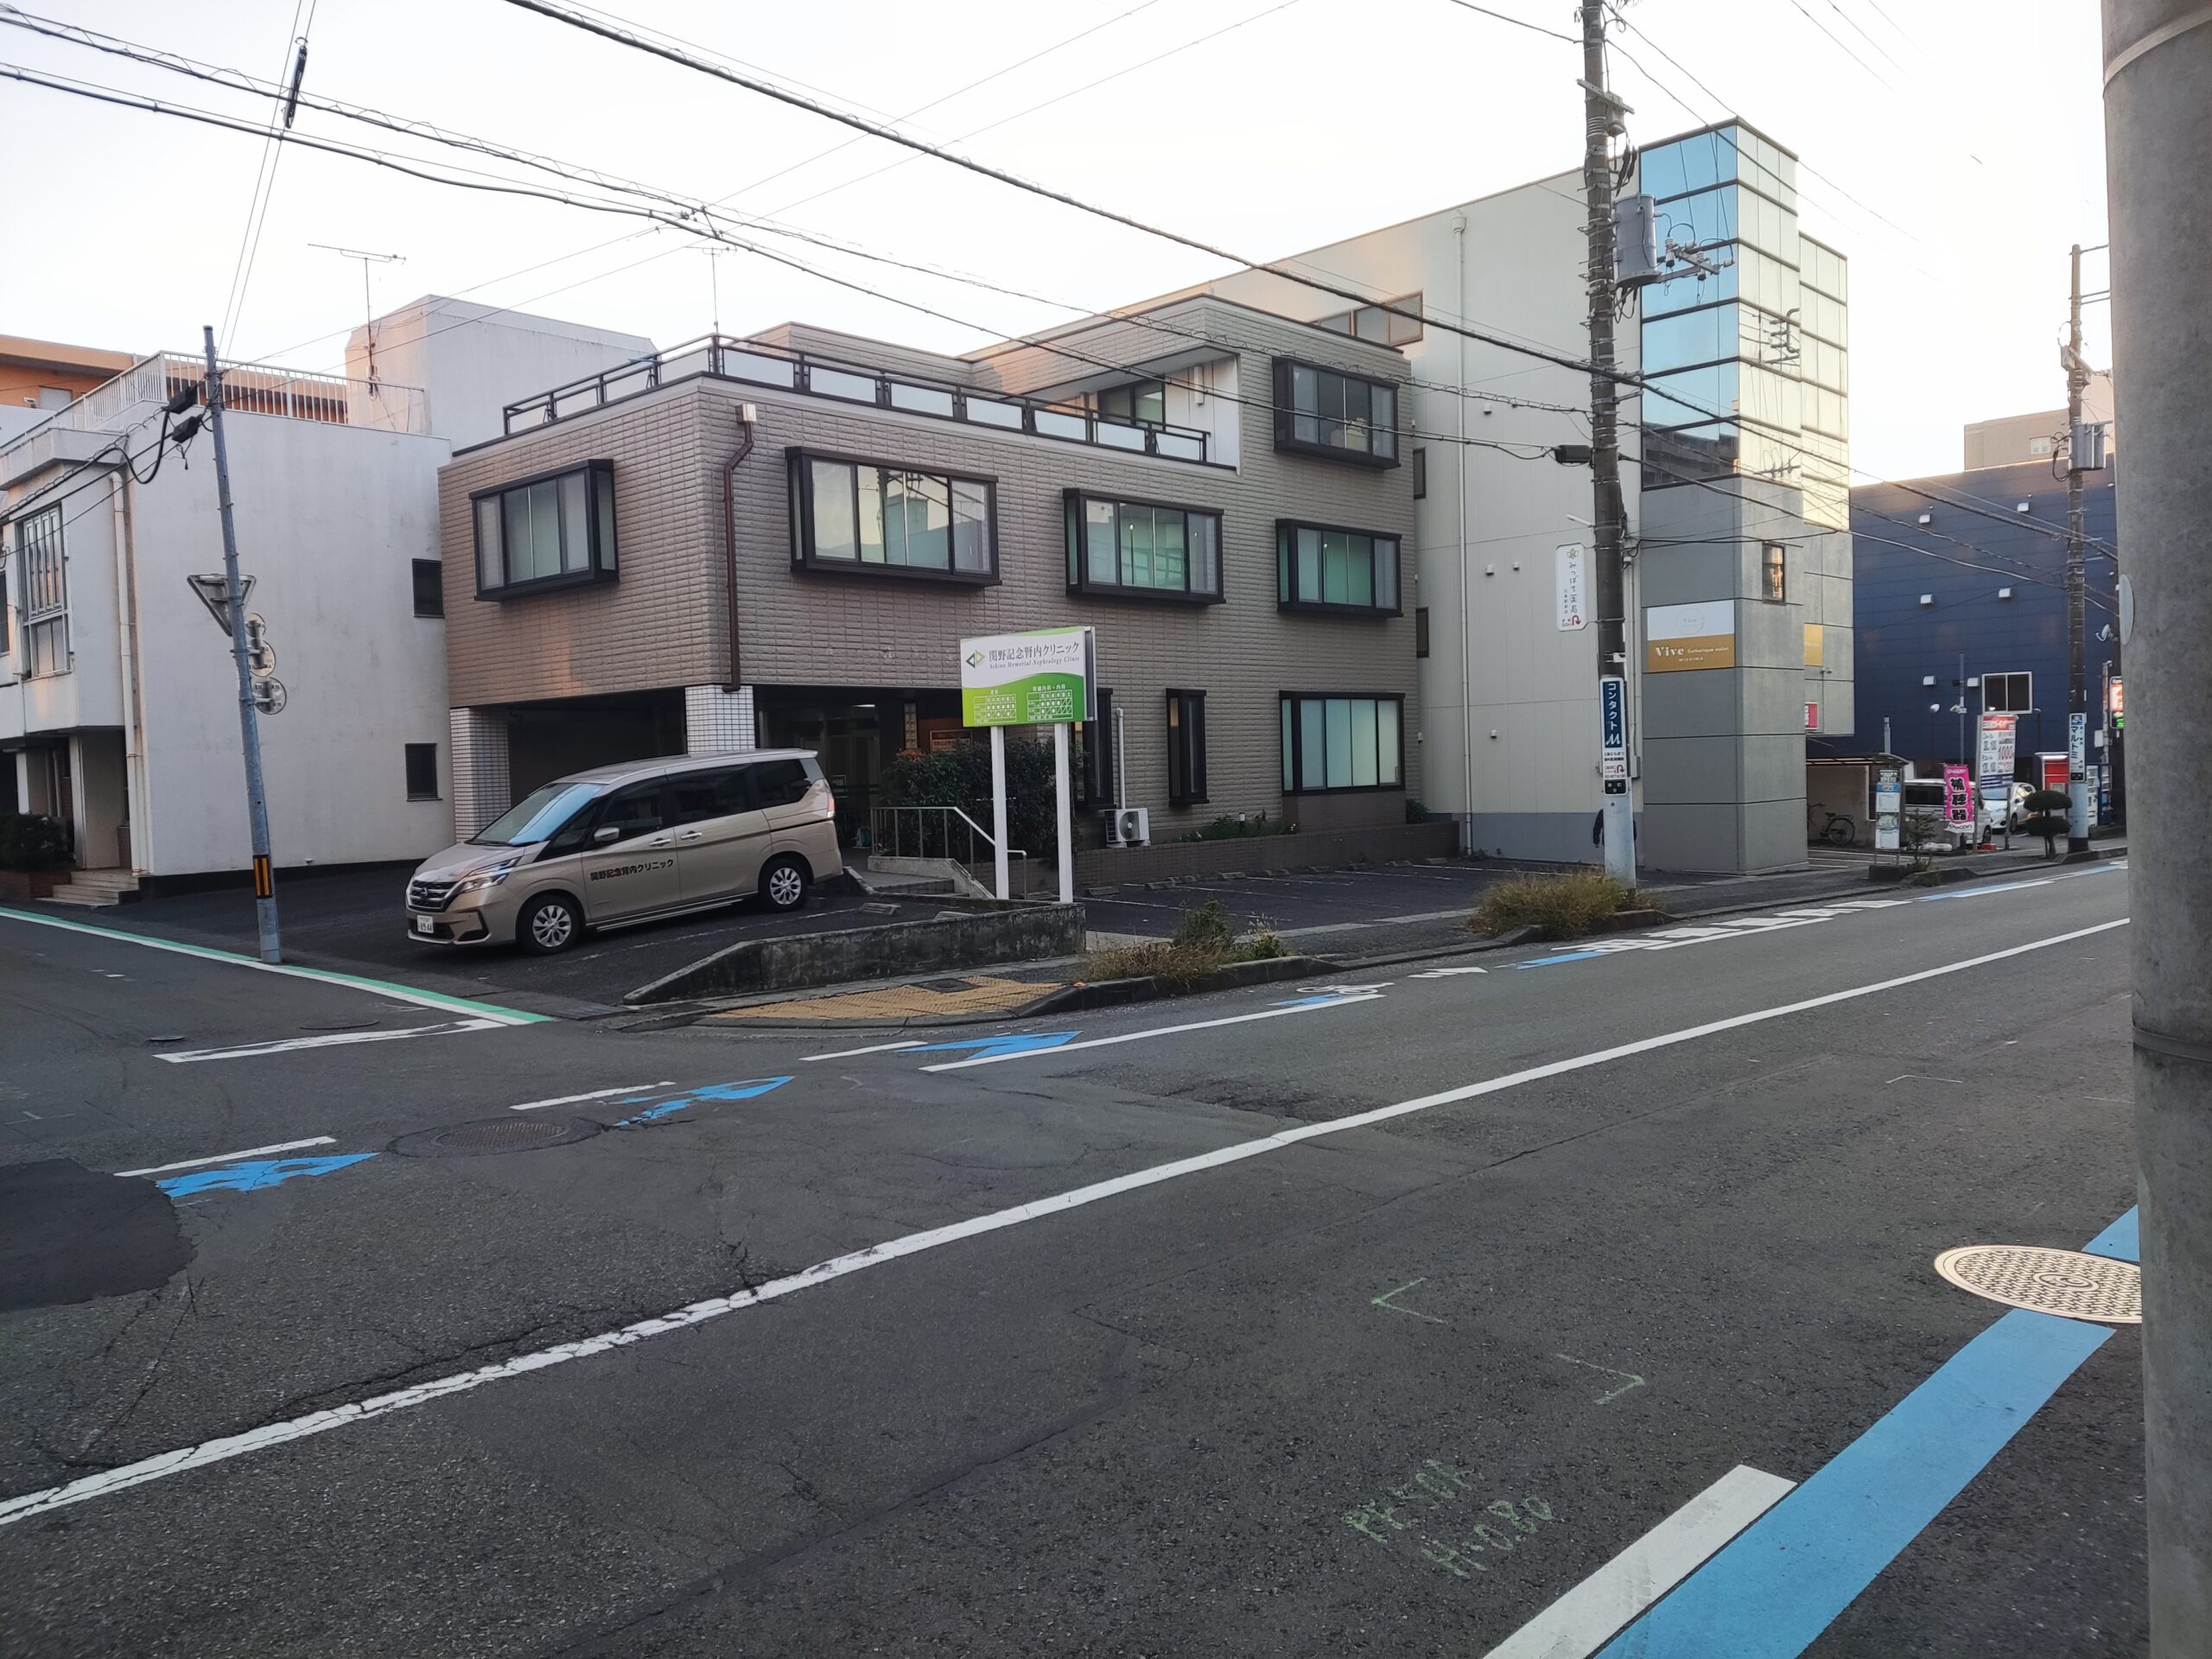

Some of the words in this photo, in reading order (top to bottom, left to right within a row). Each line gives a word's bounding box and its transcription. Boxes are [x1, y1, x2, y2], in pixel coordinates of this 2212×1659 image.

[1656, 646, 1685, 657] Vive
[2071, 726, 2080, 760] マルトミ
[1950, 778, 1967, 821] 補聴器
